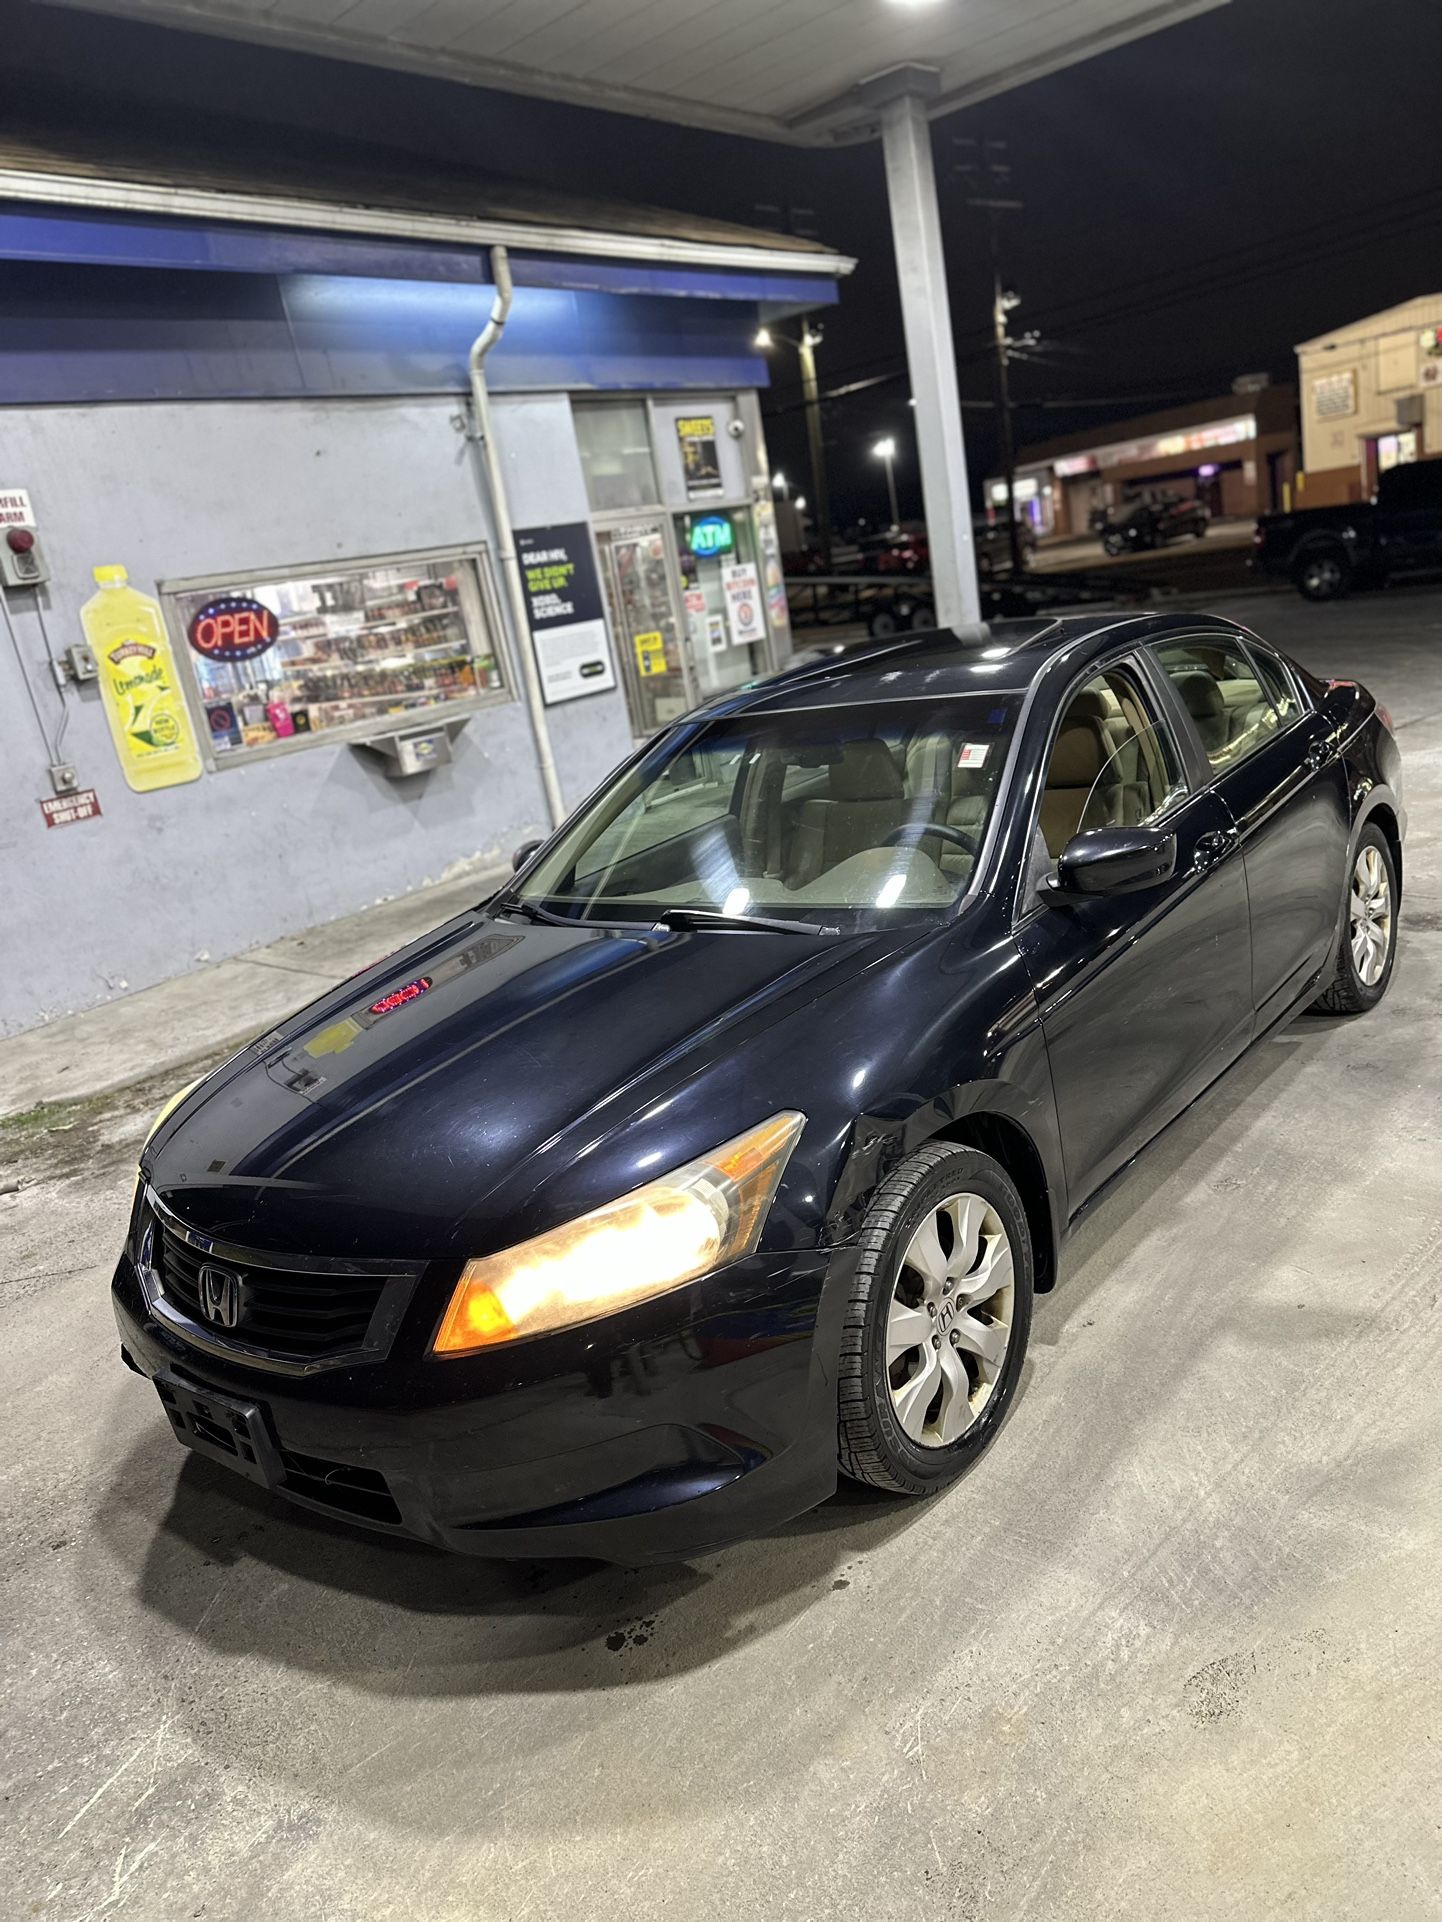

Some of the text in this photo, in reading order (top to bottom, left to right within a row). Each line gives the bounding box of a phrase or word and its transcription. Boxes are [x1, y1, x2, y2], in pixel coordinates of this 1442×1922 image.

[691, 522, 732, 550] ATM
[521, 550, 547, 565] DEAR
[525, 562, 575, 581] WE DIDN'T
[528, 578, 552, 592] GIVE
[533, 601, 575, 620] SCIENCE
[196, 609, 268, 649] OPEN
[113, 665, 164, 695] Lemonade
[43, 791, 95, 814] EMERGENCY
[53, 804, 93, 824] SHUT-OFF
